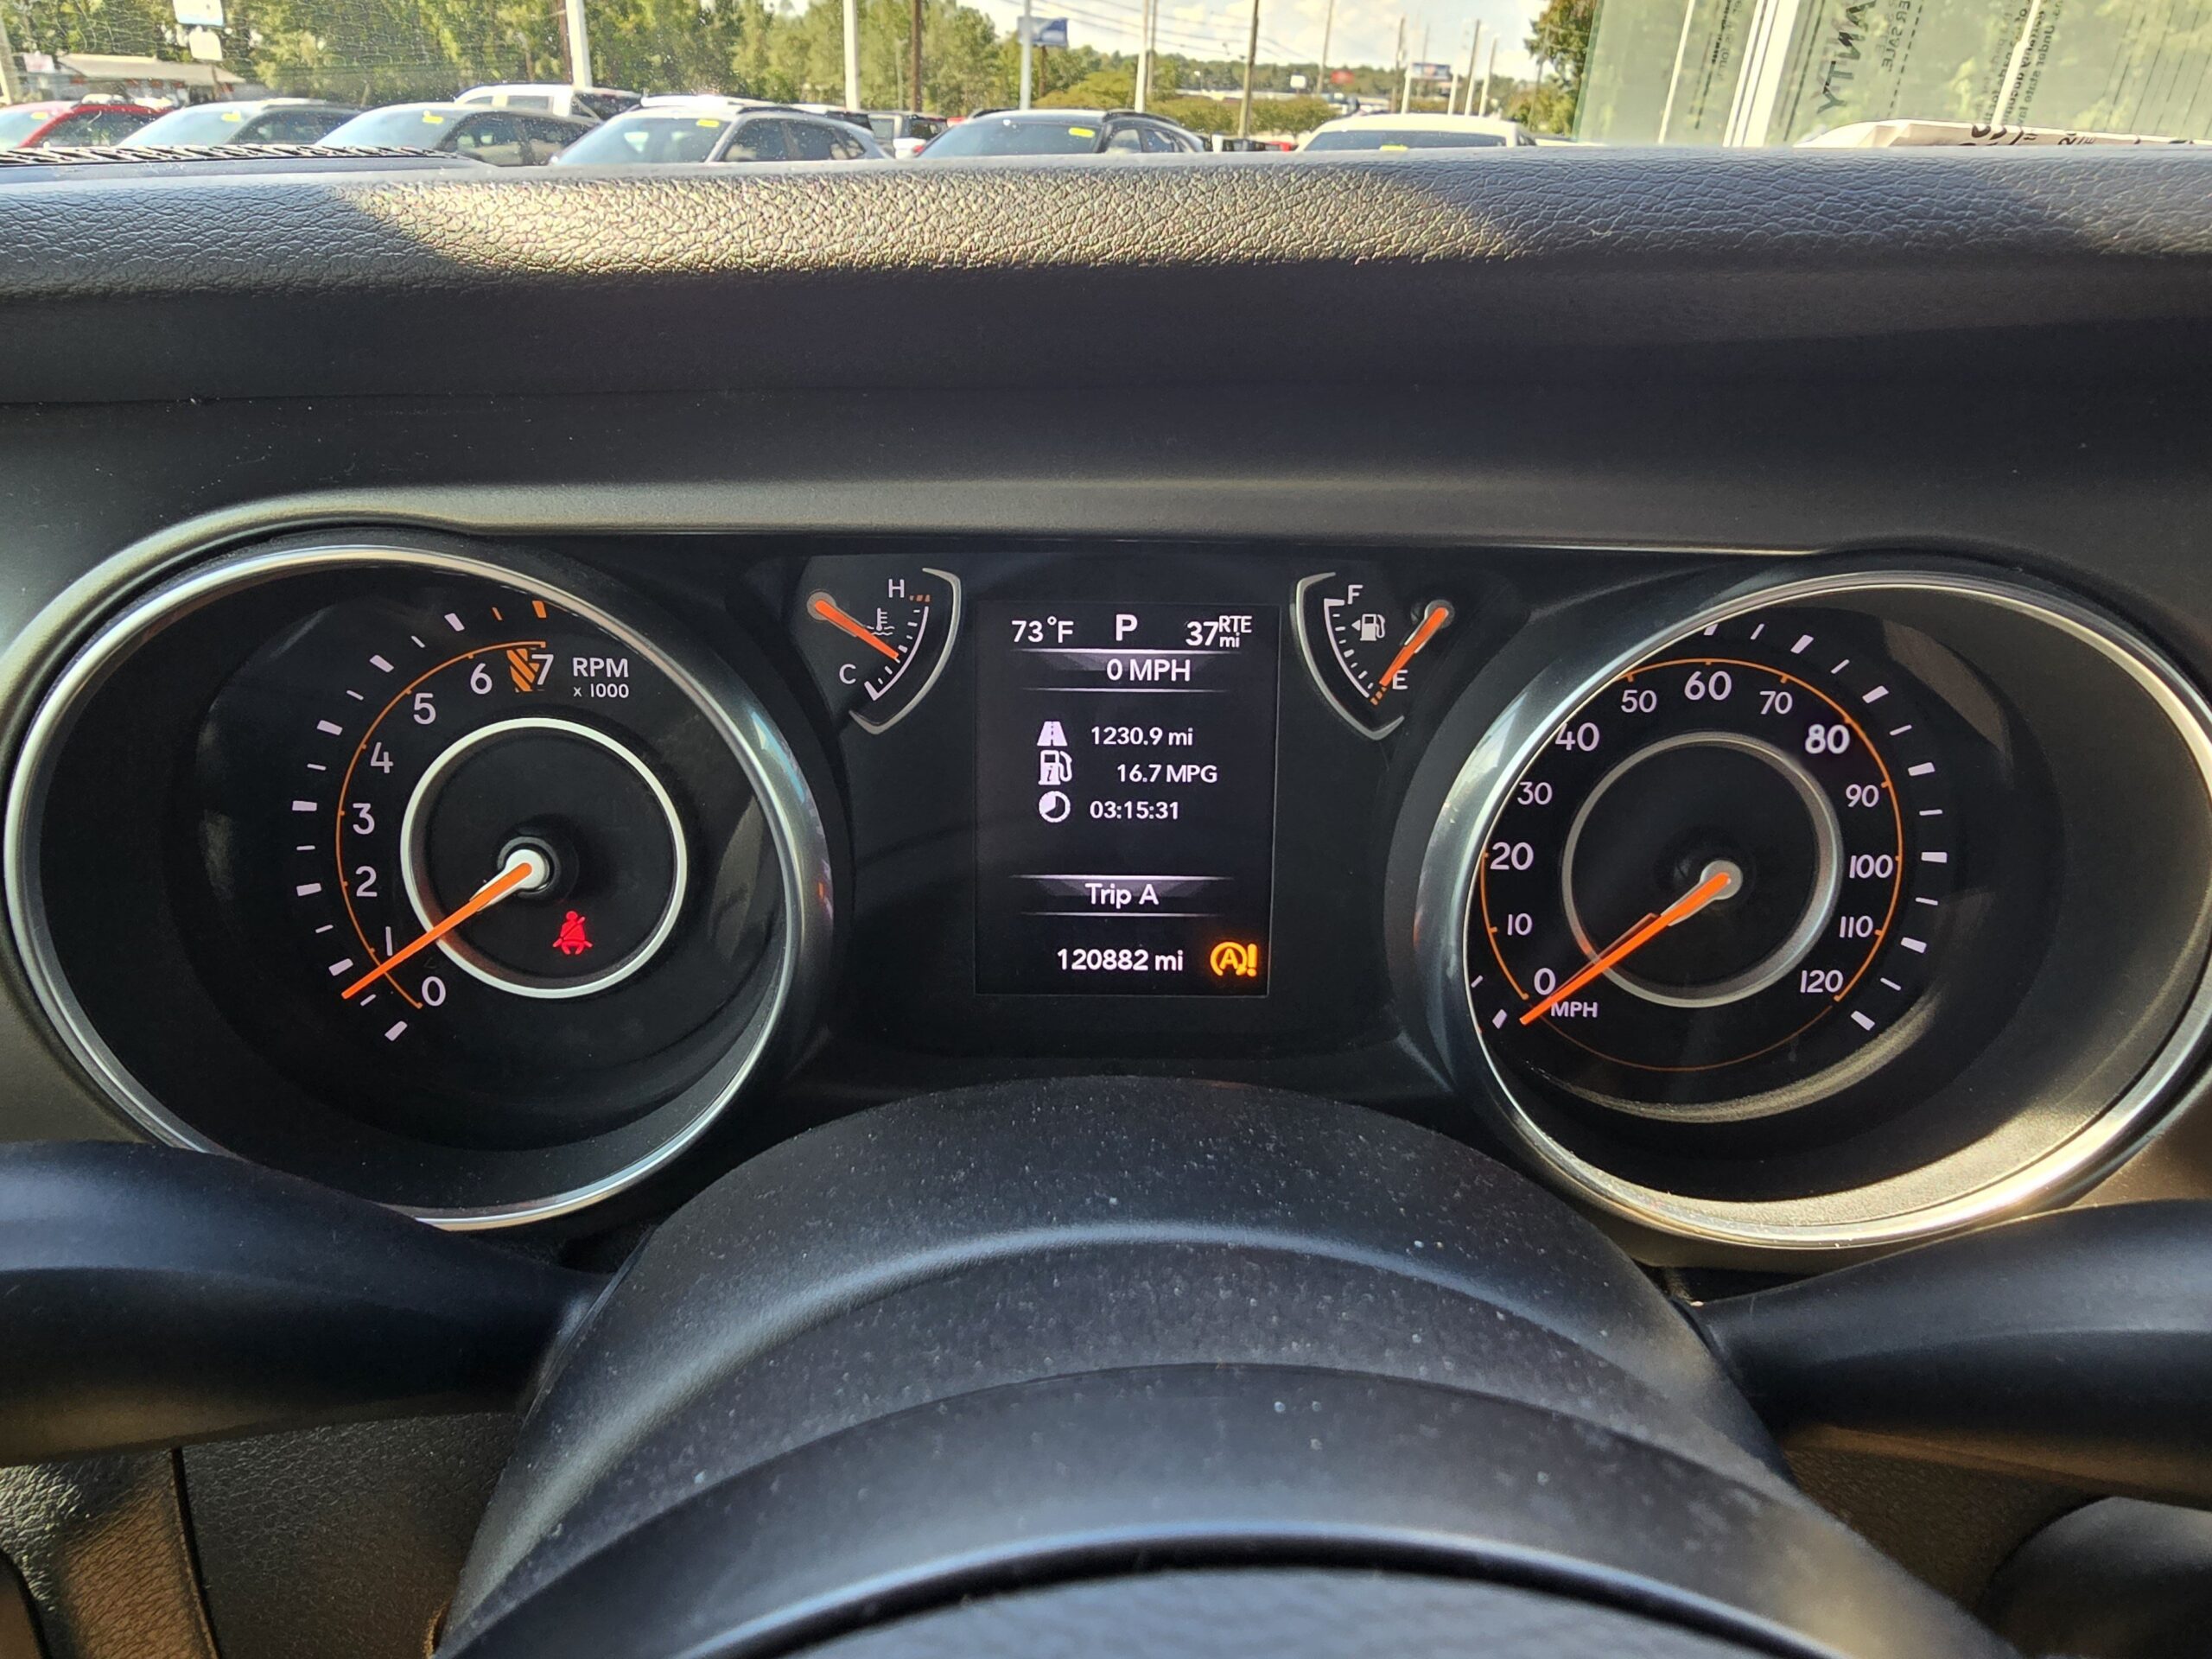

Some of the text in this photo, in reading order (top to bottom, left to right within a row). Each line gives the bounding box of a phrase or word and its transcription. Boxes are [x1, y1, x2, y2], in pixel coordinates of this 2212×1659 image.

[887, 579, 905, 598] H
[1348, 584, 1363, 605] F
[1115, 613, 1138, 641] P
[1185, 614, 1252, 646] 37 RTE
[1219, 632, 1240, 648] mi
[470, 663, 493, 694] 6
[531, 653, 554, 685] 7
[572, 657, 629, 678] RPM
[838, 664, 857, 685] C
[1106, 658, 1191, 682] 0 MPH
[1392, 670, 1408, 690] E
[590, 683, 629, 698] 1000
[1684, 671, 1732, 701] 60
[413, 693, 436, 725] 5
[1620, 690, 1657, 713] 50
[1759, 691, 1794, 715] 70
[1090, 727, 1193, 746] 1230.9 mi
[1554, 722, 1599, 753] 40
[1805, 724, 1850, 755] 80
[370, 742, 393, 773] 4
[1117, 764, 1218, 784] 16.7 MPG
[1516, 781, 1553, 806] 30
[1845, 784, 1880, 810] 90
[352, 804, 375, 835] 3
[1090, 801, 1179, 820] 03:15:31
[1490, 842, 1535, 871] 20
[1848, 854, 1894, 879] 100
[355, 866, 378, 897] 2
[1084, 883, 1160, 909] Trip A
[1506, 912, 1533, 937] 10
[1839, 915, 1874, 938] 110
[1057, 948, 1184, 971] 120882 mi
[422, 976, 446, 1007] 0
[1533, 968, 1556, 996] 0
[1800, 970, 1843, 994] 120
[1550, 1001, 1599, 1019] MPH
